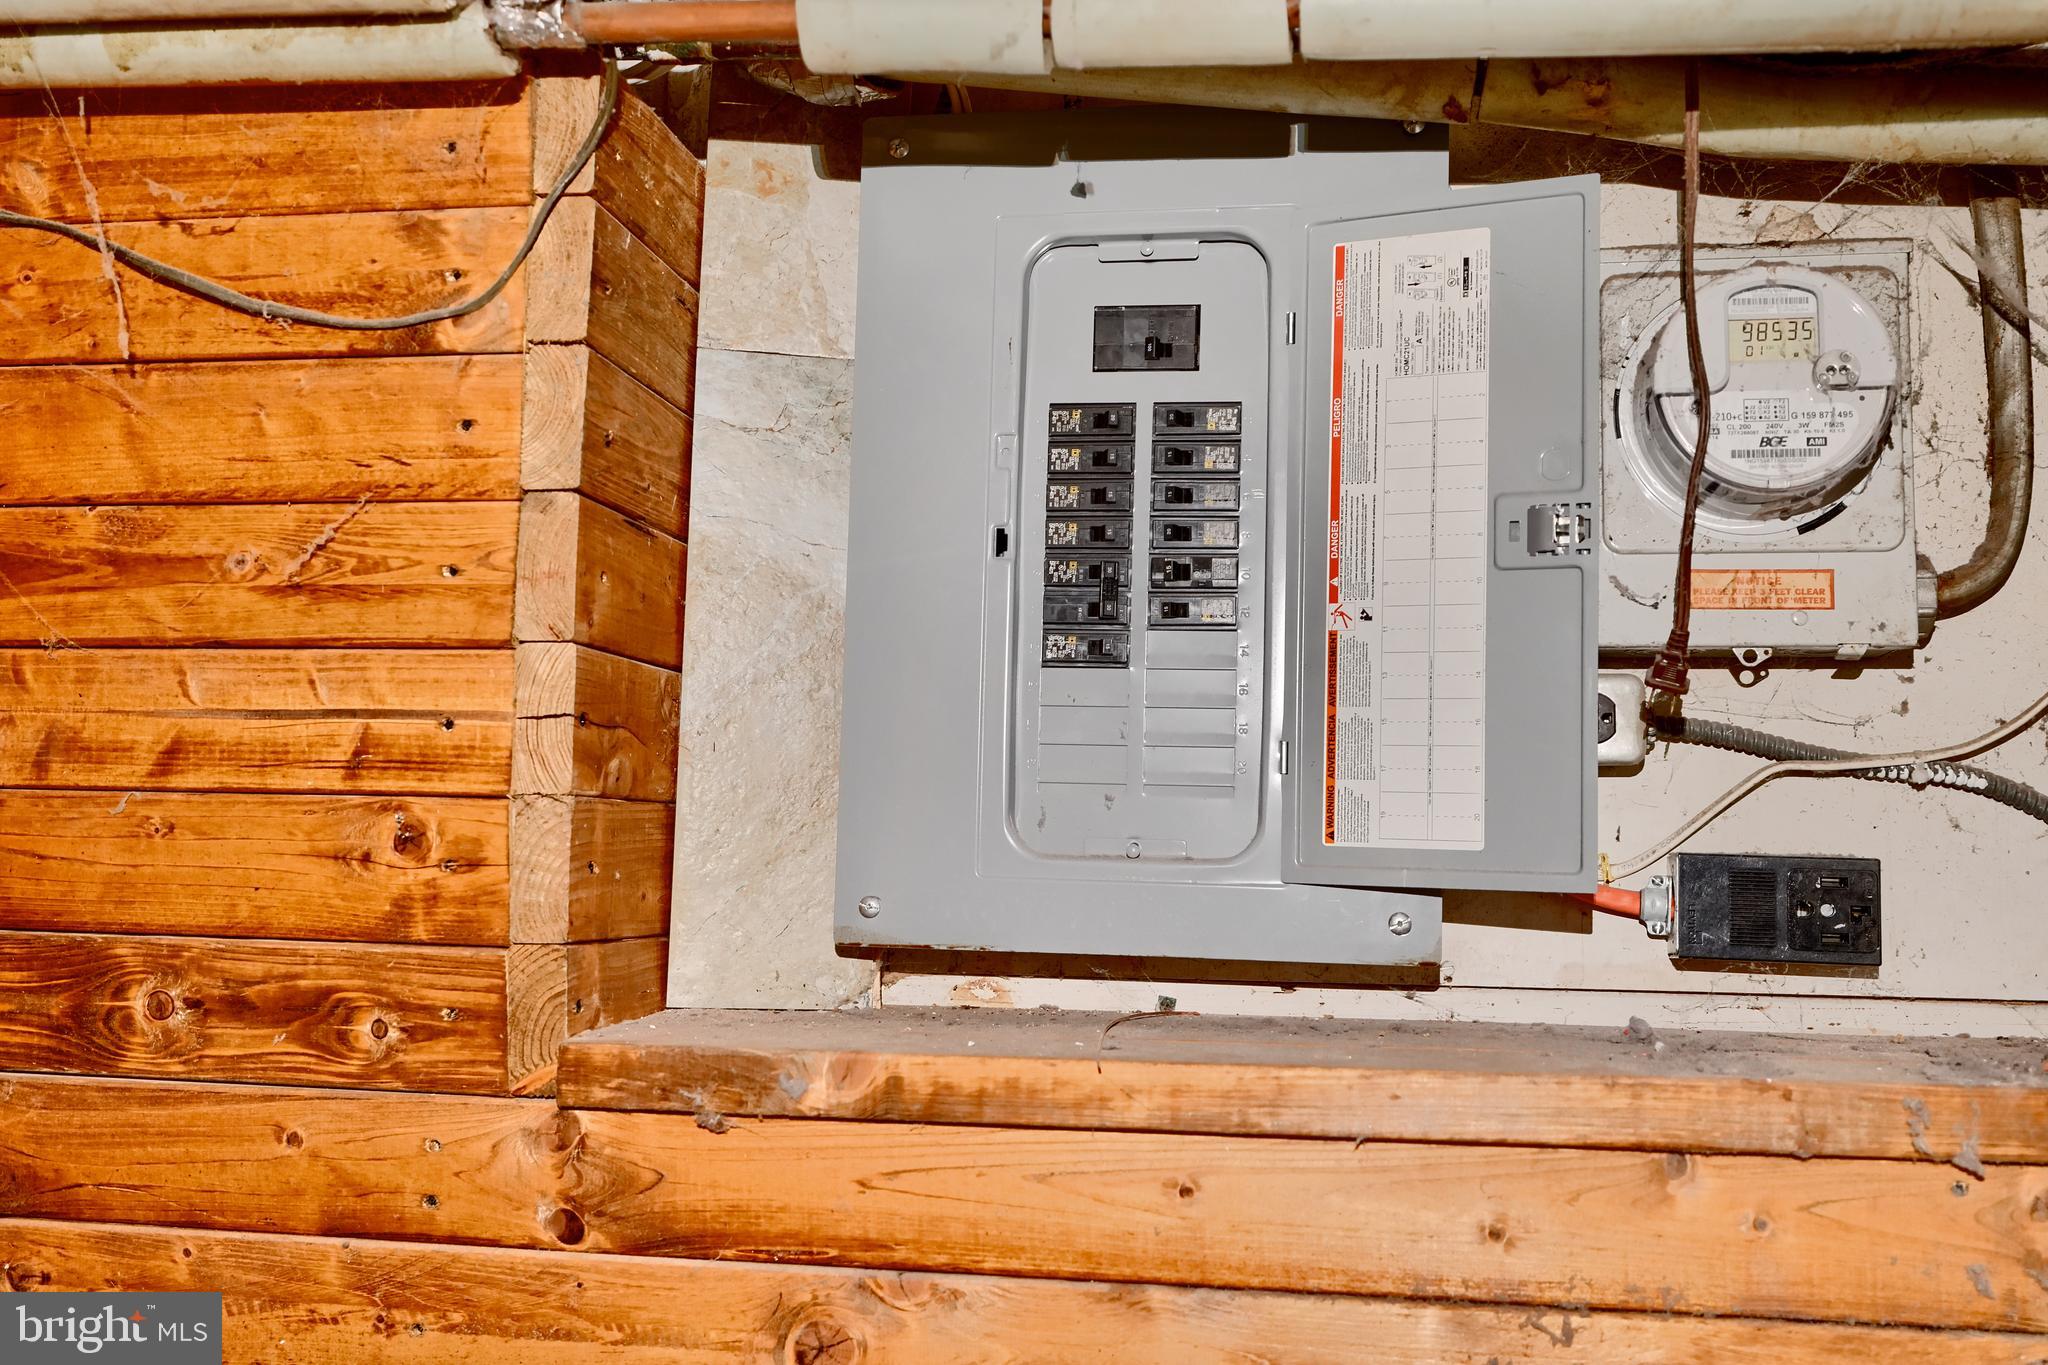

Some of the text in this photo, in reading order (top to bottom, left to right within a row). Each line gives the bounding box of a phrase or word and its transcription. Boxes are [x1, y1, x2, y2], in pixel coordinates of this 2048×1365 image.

[1336, 279, 1344, 317] DANGER
[1742, 320, 1812, 342] 98535
[1746, 346, 1764, 357] 01
[1333, 397, 1341, 438] PELIGRO
[1791, 412, 1798, 420] G
[1838, 410, 1854, 418] 495
[1759, 436, 1825, 448] BGE AMI
[1240, 568, 1252, 580] 10
[1692, 588, 1728, 596] PLEASE
[1795, 588, 1825, 596] CLEAR
[1240, 606, 1250, 618] 12
[1239, 644, 1250, 657] 14
[1328, 633, 1337, 707] AVERTISSEMENT
[1238, 682, 1249, 696] 16
[1238, 722, 1248, 734] 18
[1327, 714, 1336, 779] ADVERTENCIA
[1237, 760, 1247, 774] 20
[1326, 785, 1335, 829] WARNING
